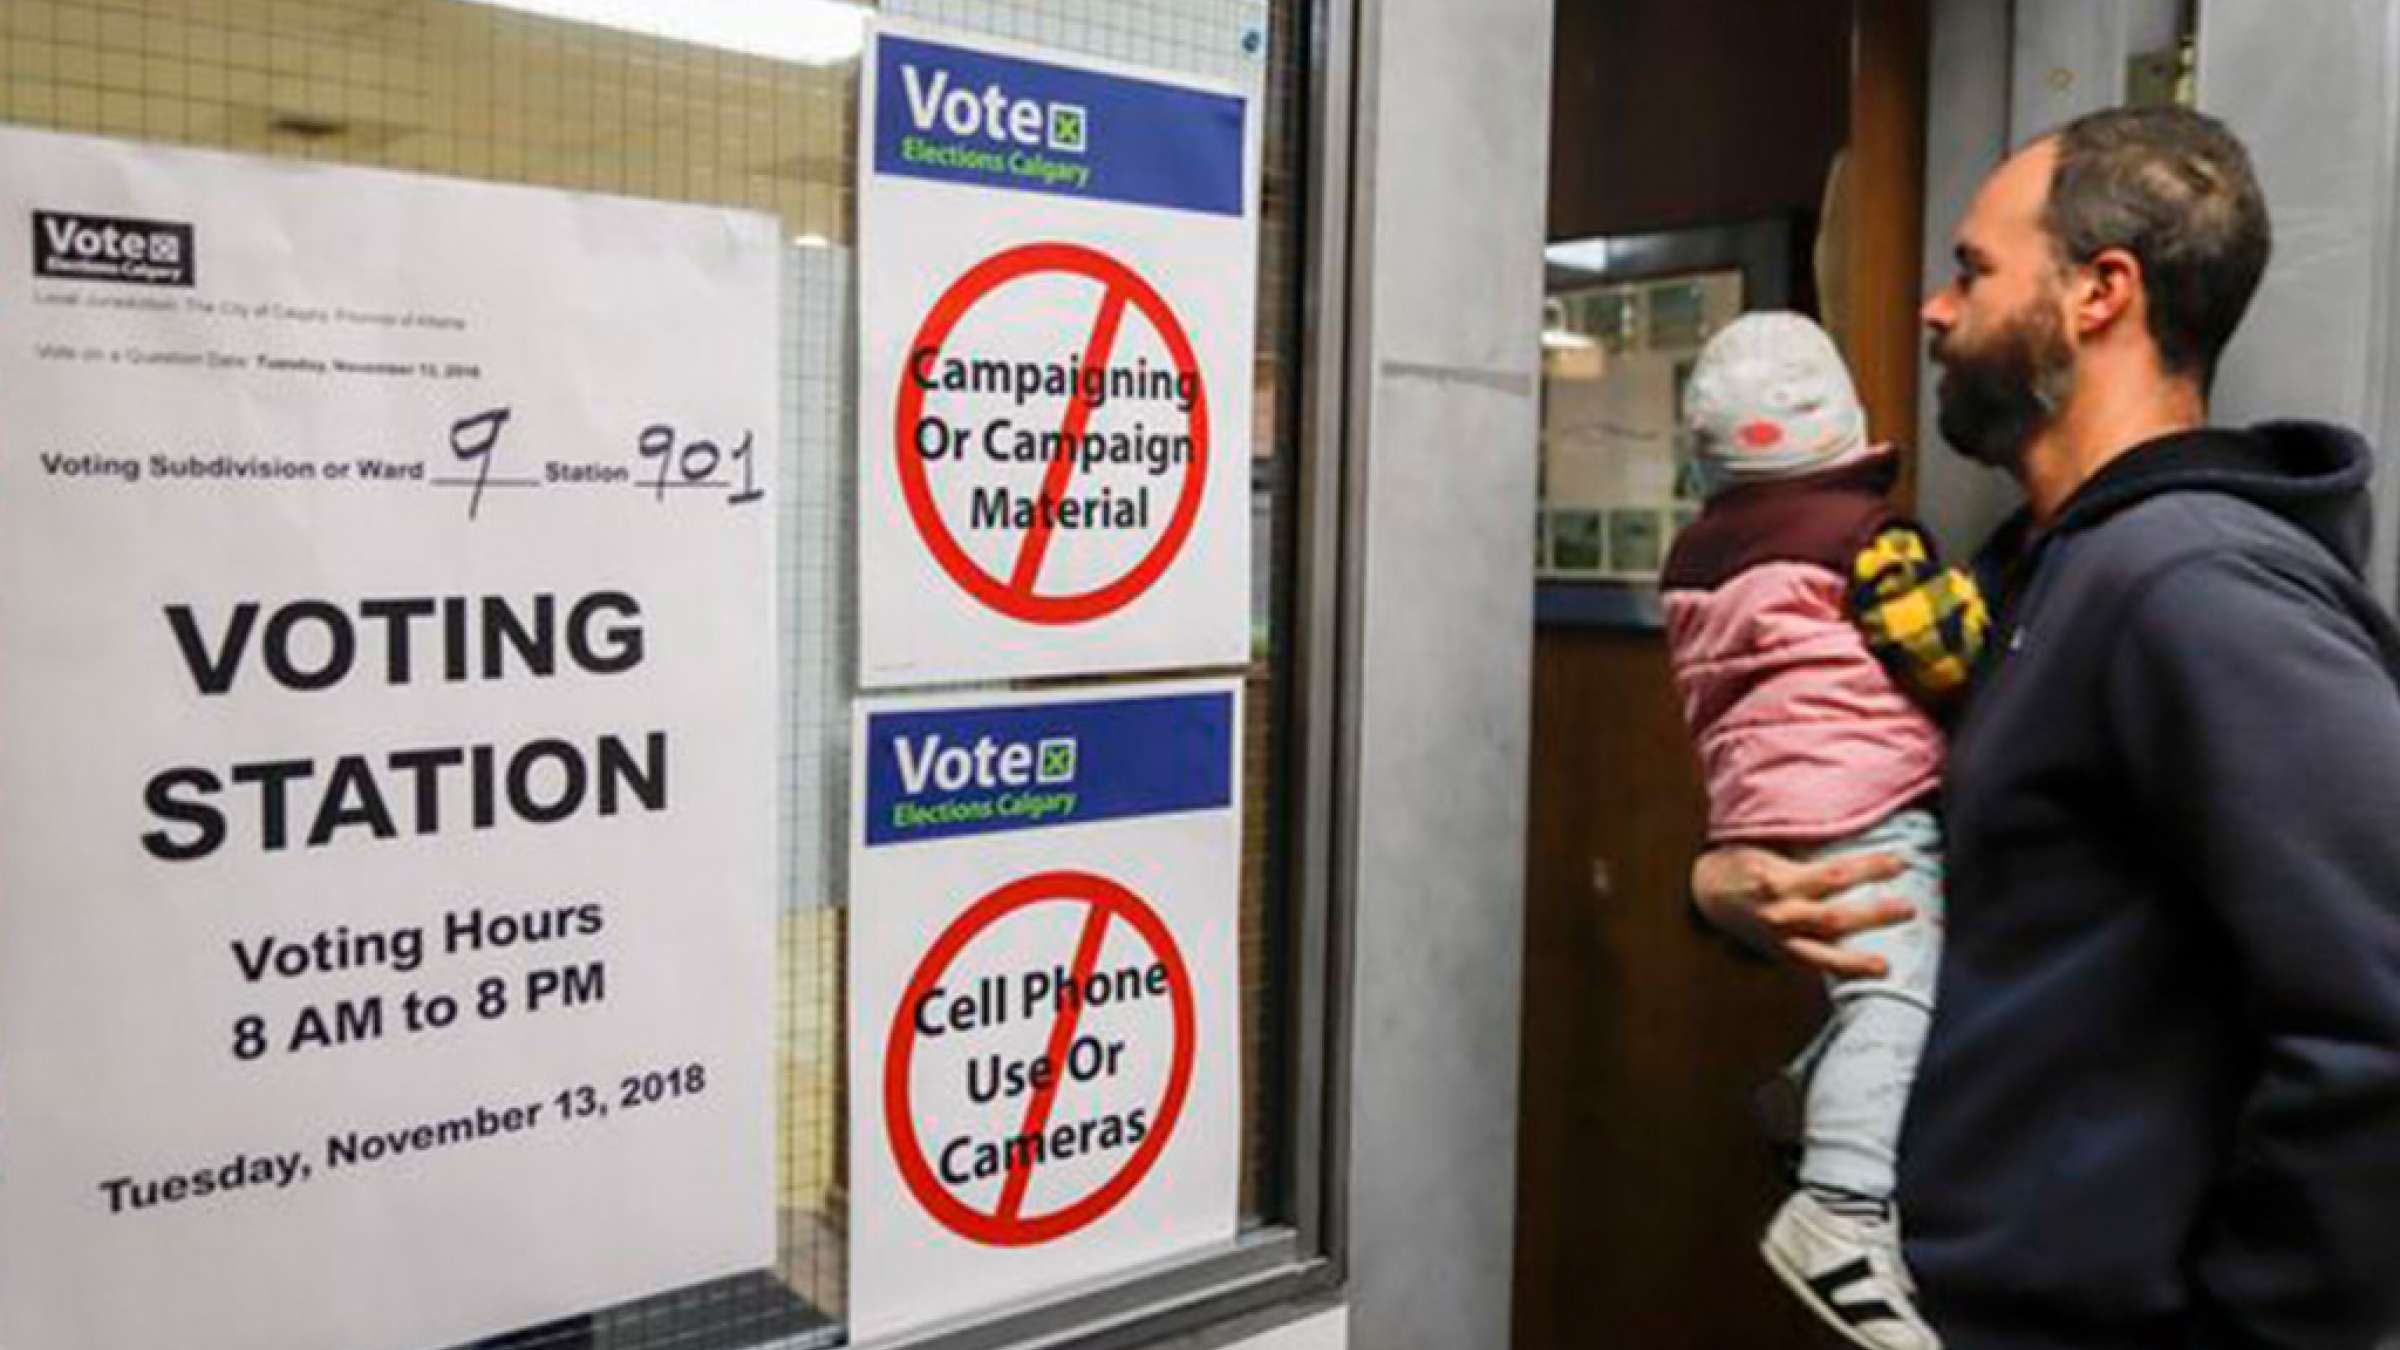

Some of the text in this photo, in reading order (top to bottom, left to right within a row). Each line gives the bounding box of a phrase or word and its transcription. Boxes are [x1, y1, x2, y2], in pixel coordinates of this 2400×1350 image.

[902, 64, 1043, 143] Vote
[902, 135, 1089, 187] Elections Calgary
[44, 217, 146, 258] Vote
[910, 346, 1200, 411] Campaigning
[40, 406, 765, 520] Voting Subdivision or Ward 9 Station 901
[914, 416, 1195, 474] Or Campaign
[970, 486, 1150, 530] Material
[164, 591, 645, 696] VOTING
[141, 731, 667, 862] STATION
[893, 734, 1032, 795] Vote
[892, 792, 1077, 828] Elections Calgary
[231, 903, 604, 983] Voting Hours
[231, 962, 606, 1061] 8 AM to 8 PM
[913, 961, 1171, 1037] Cell Phone
[966, 1035, 1127, 1104] Use Or
[100, 1063, 706, 1213] Tuesday, November 13, 2018
[939, 1108, 1147, 1185] Cameras
